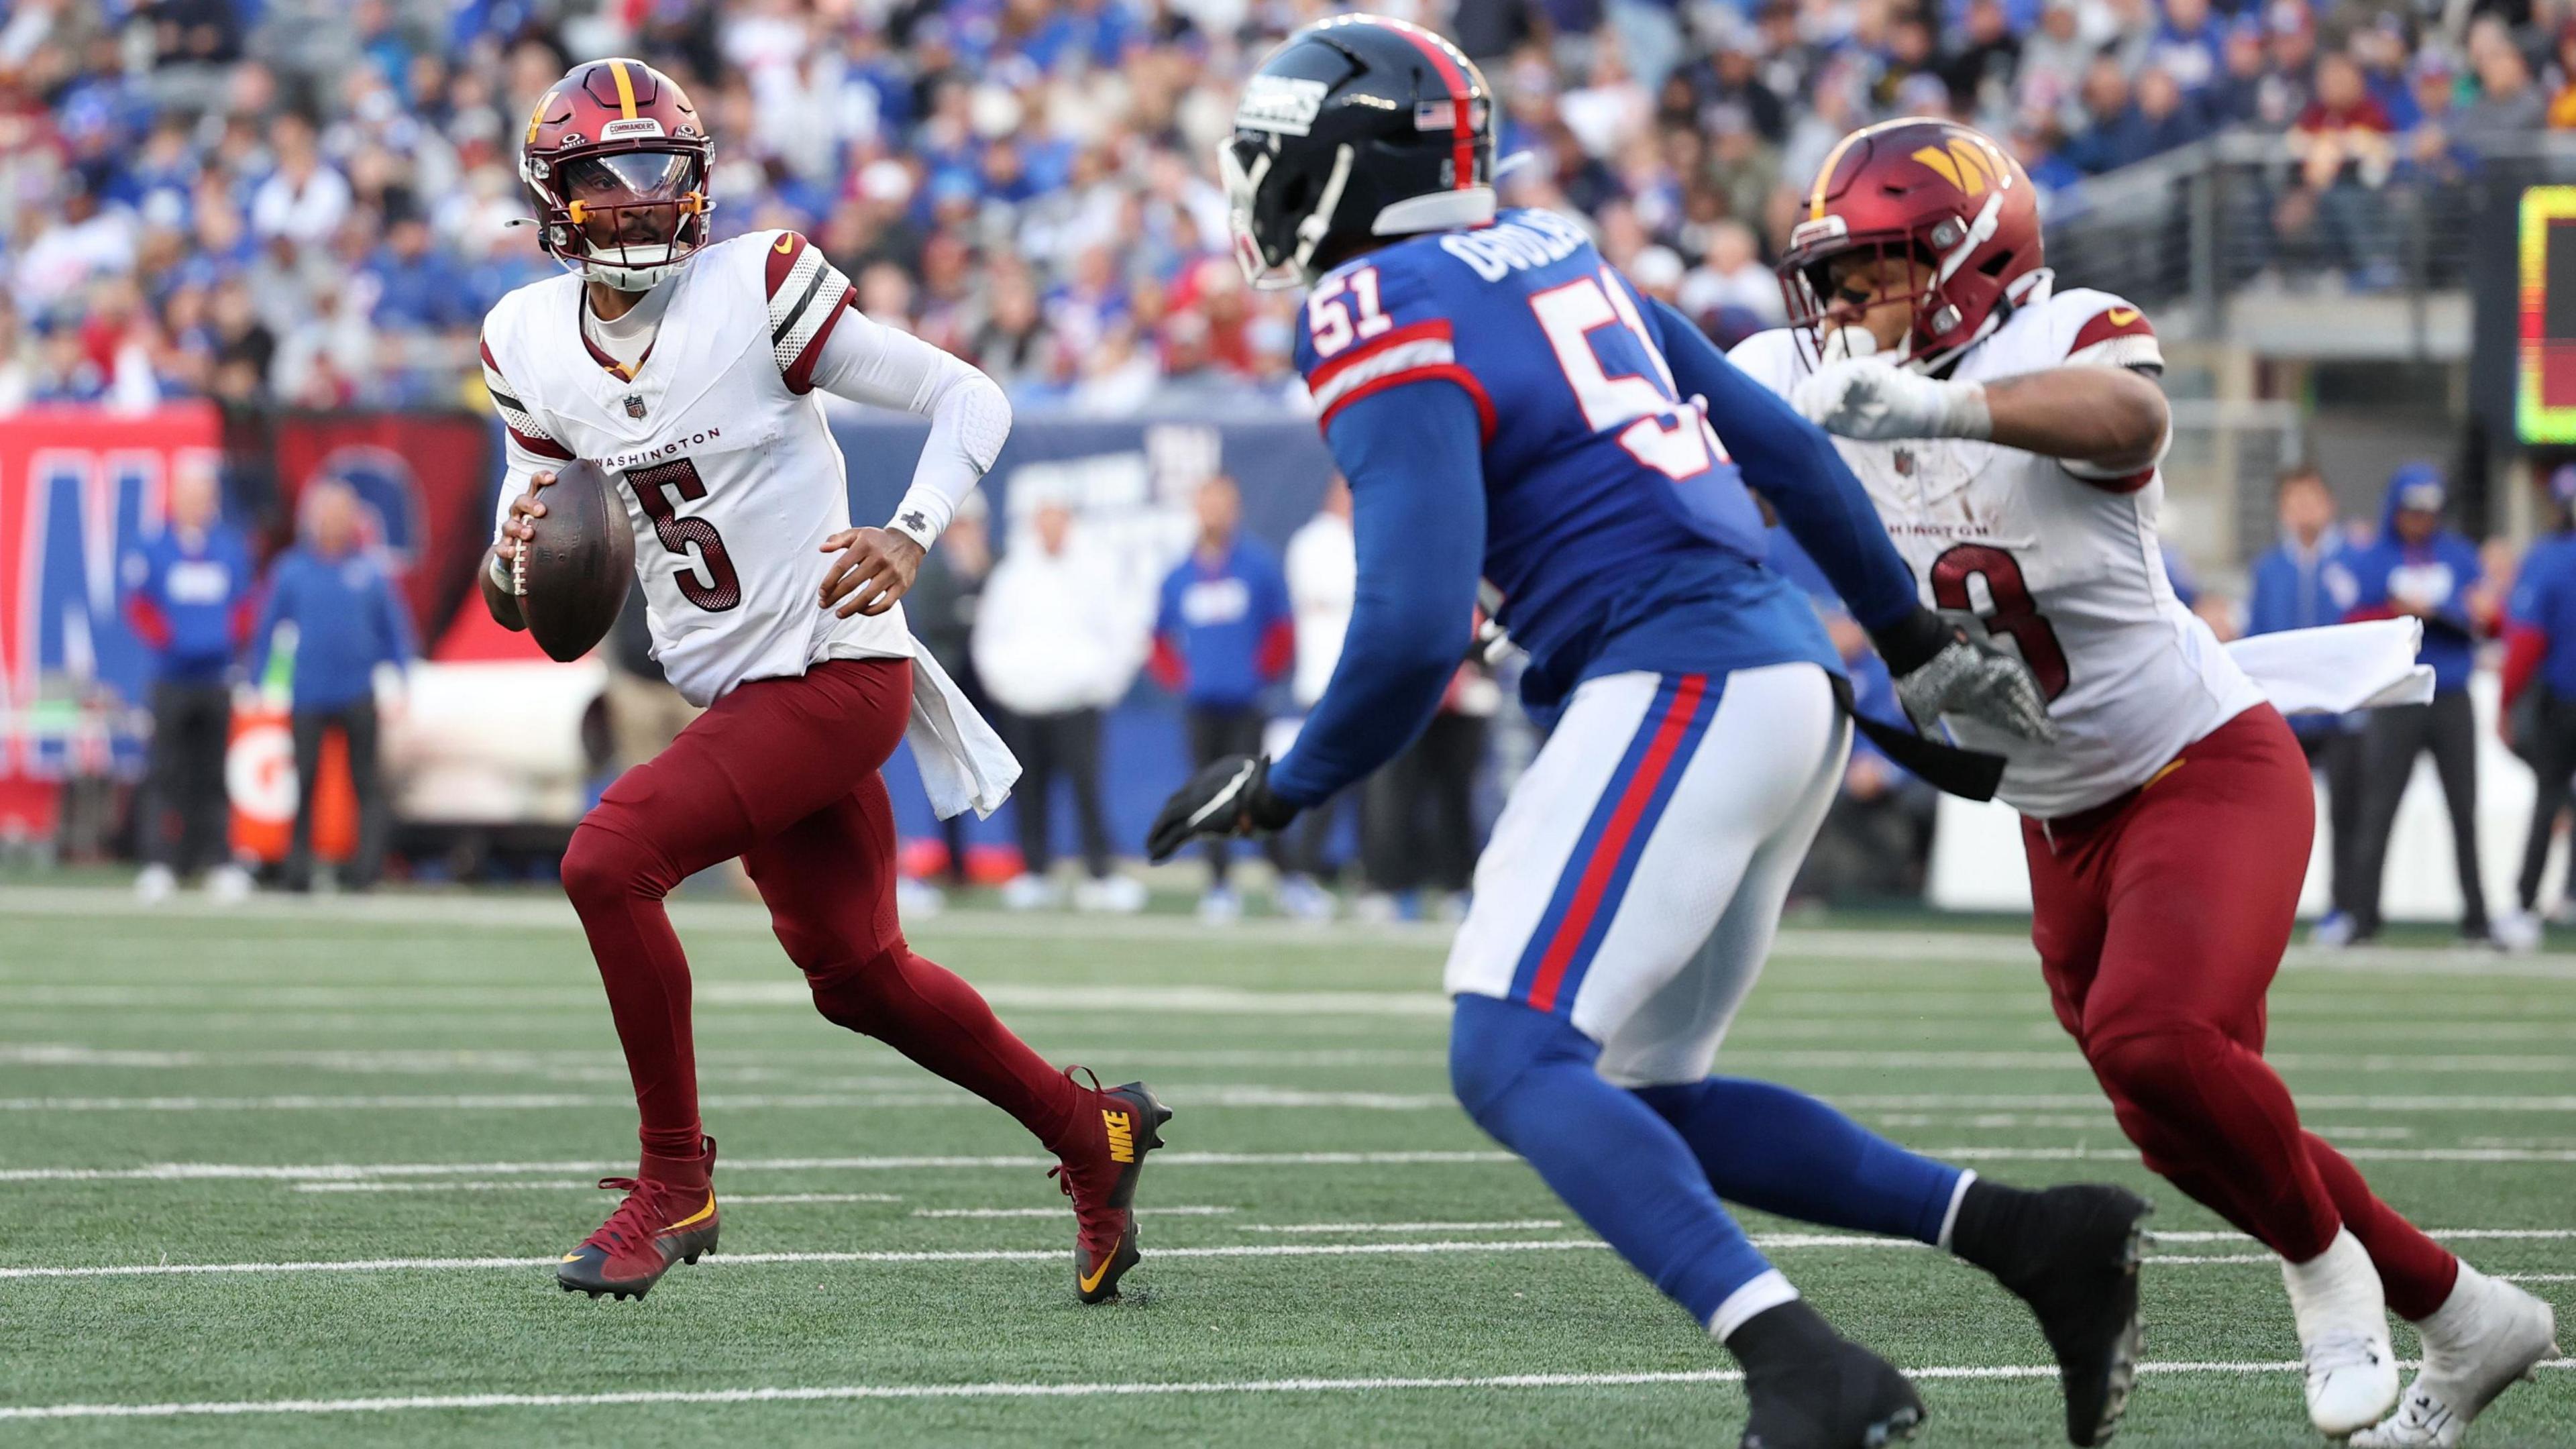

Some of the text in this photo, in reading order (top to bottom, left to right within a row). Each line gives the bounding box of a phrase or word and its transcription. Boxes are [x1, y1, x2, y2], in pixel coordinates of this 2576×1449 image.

[609, 122, 655, 133] COMMANDERS
[1307, 266, 1393, 359] 51
[629, 404, 644, 417] NFL
[592, 427, 720, 468] WASHINGTON
[623, 457, 741, 612] 5
[1929, 542, 2070, 704] 3
[1101, 1109, 1134, 1163] NIKE
